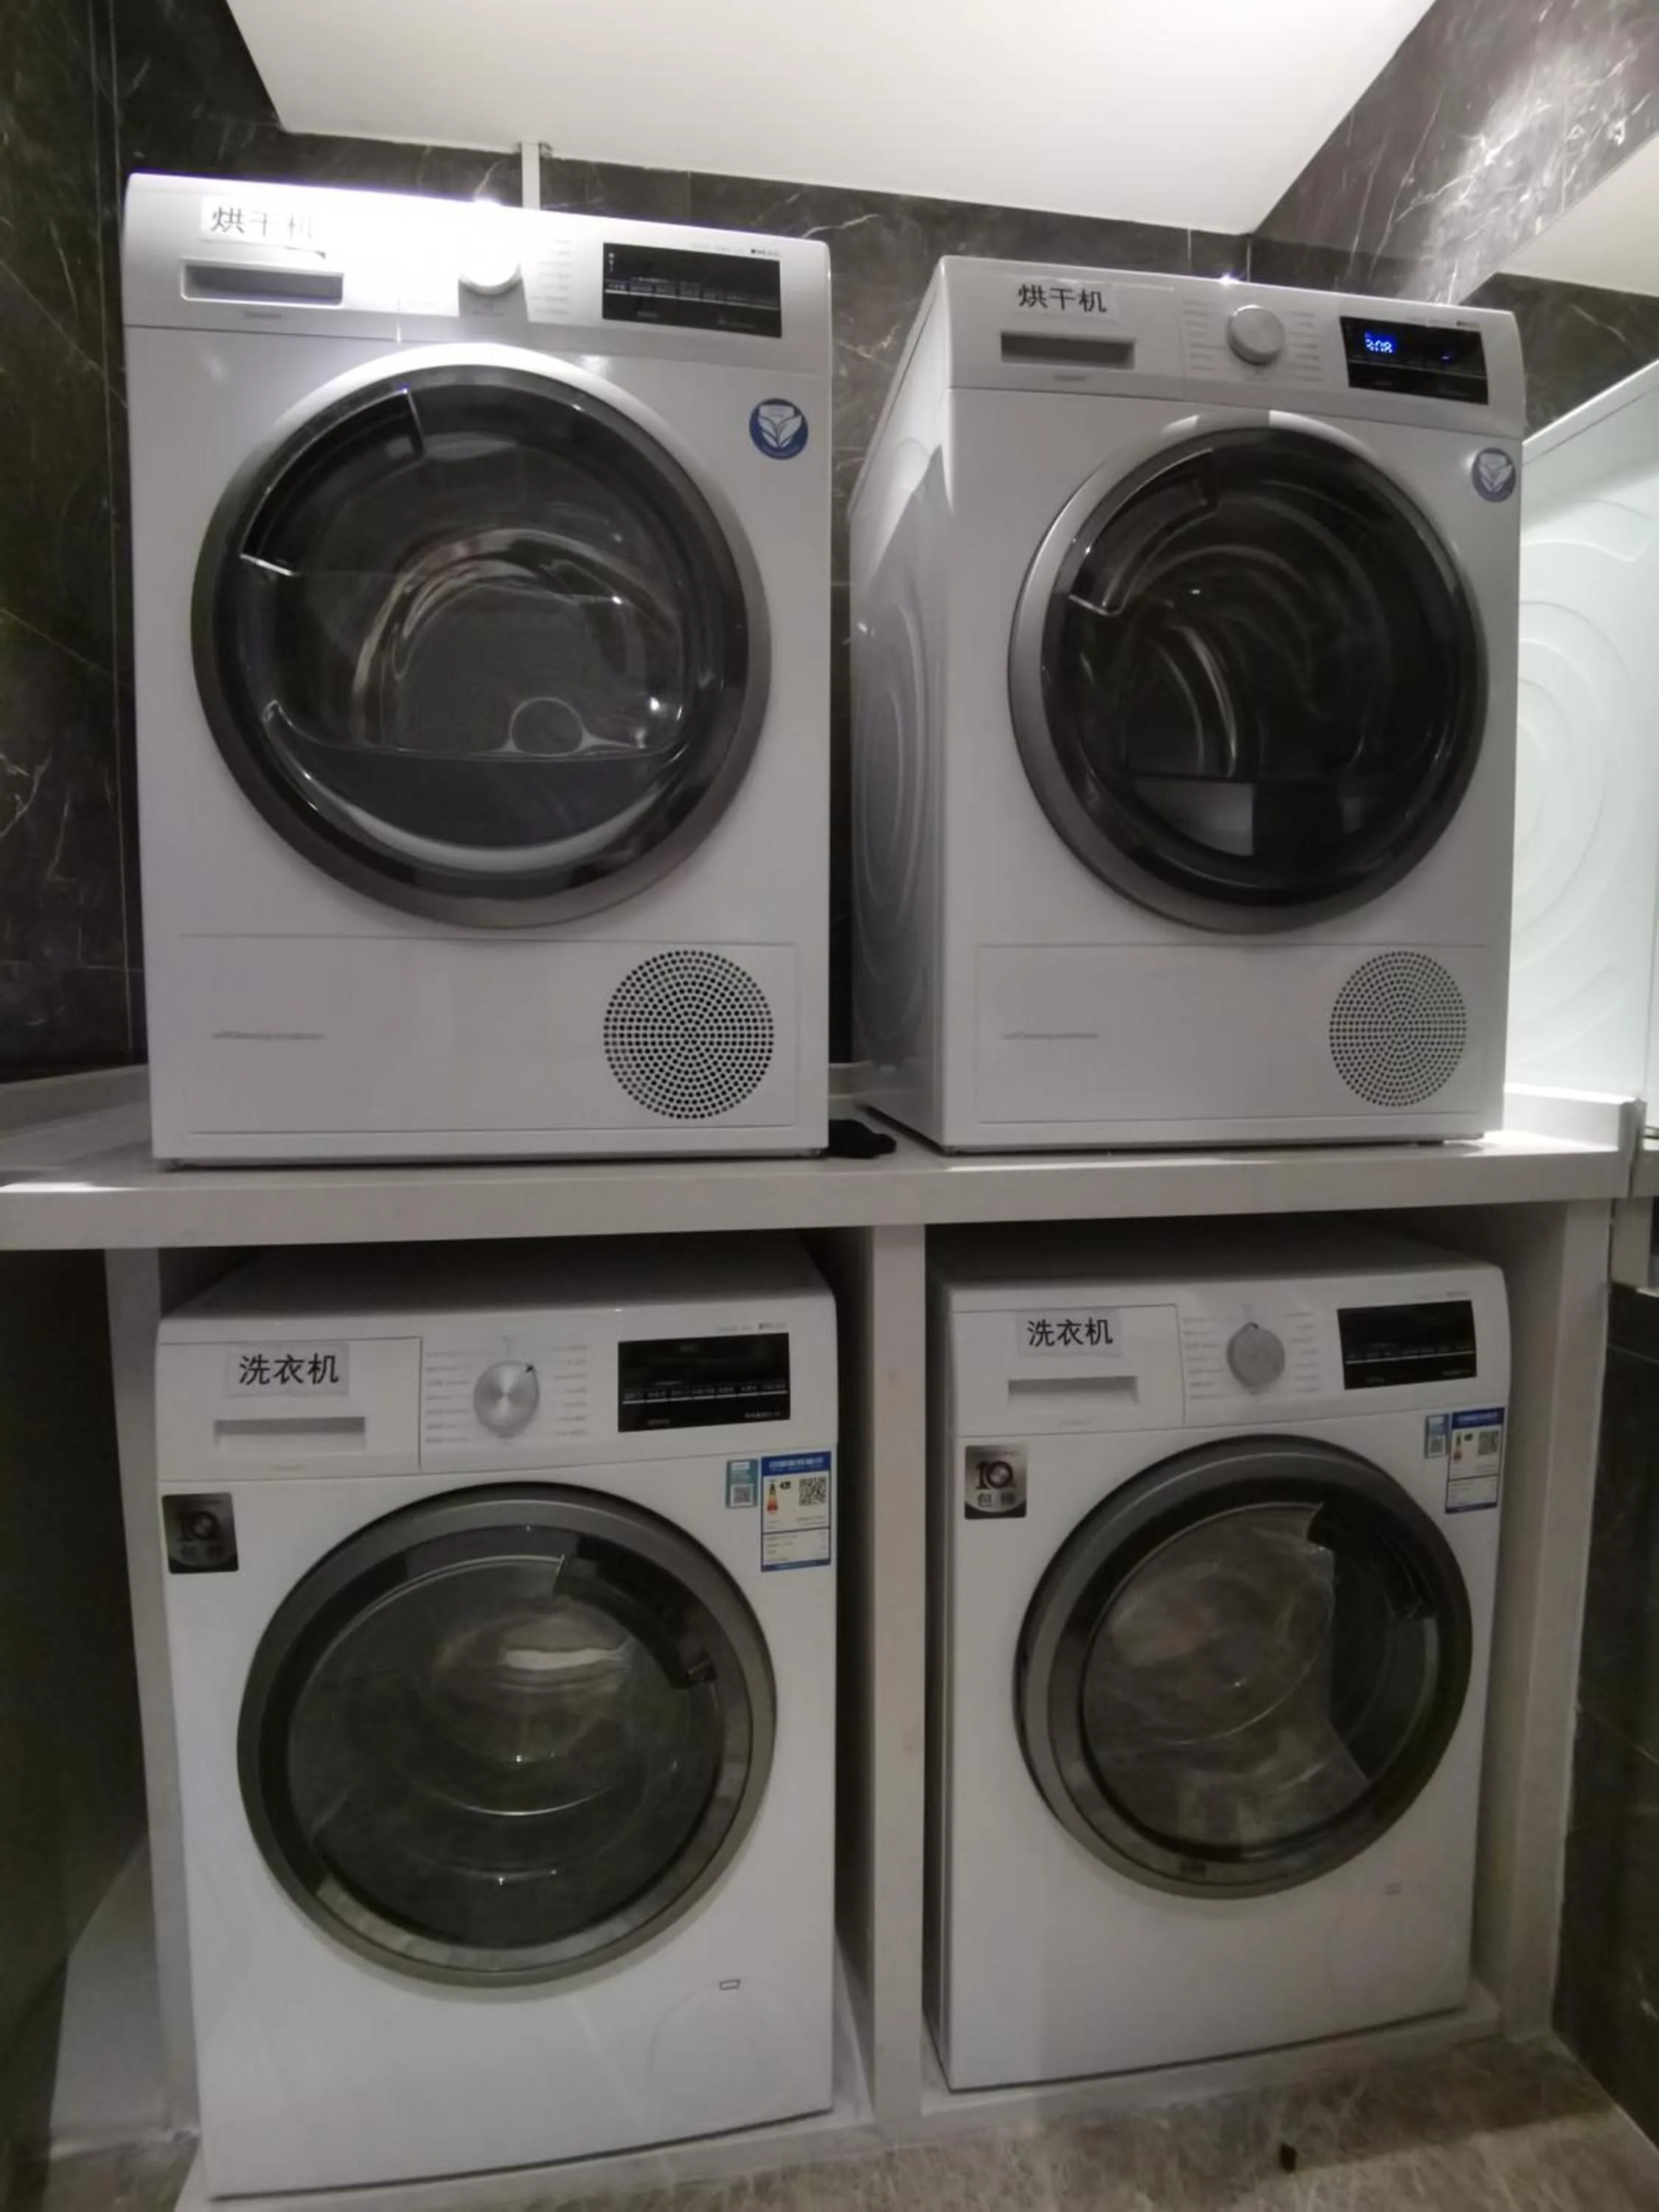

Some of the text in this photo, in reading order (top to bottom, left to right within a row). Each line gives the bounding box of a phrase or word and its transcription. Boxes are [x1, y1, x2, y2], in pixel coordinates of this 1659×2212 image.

[211, 206, 313, 240] 烘干机
[1018, 283, 1107, 313] 烘干机
[1027, 1318, 1113, 1348] 洗衣机
[239, 1353, 339, 1386] 洗衣机
